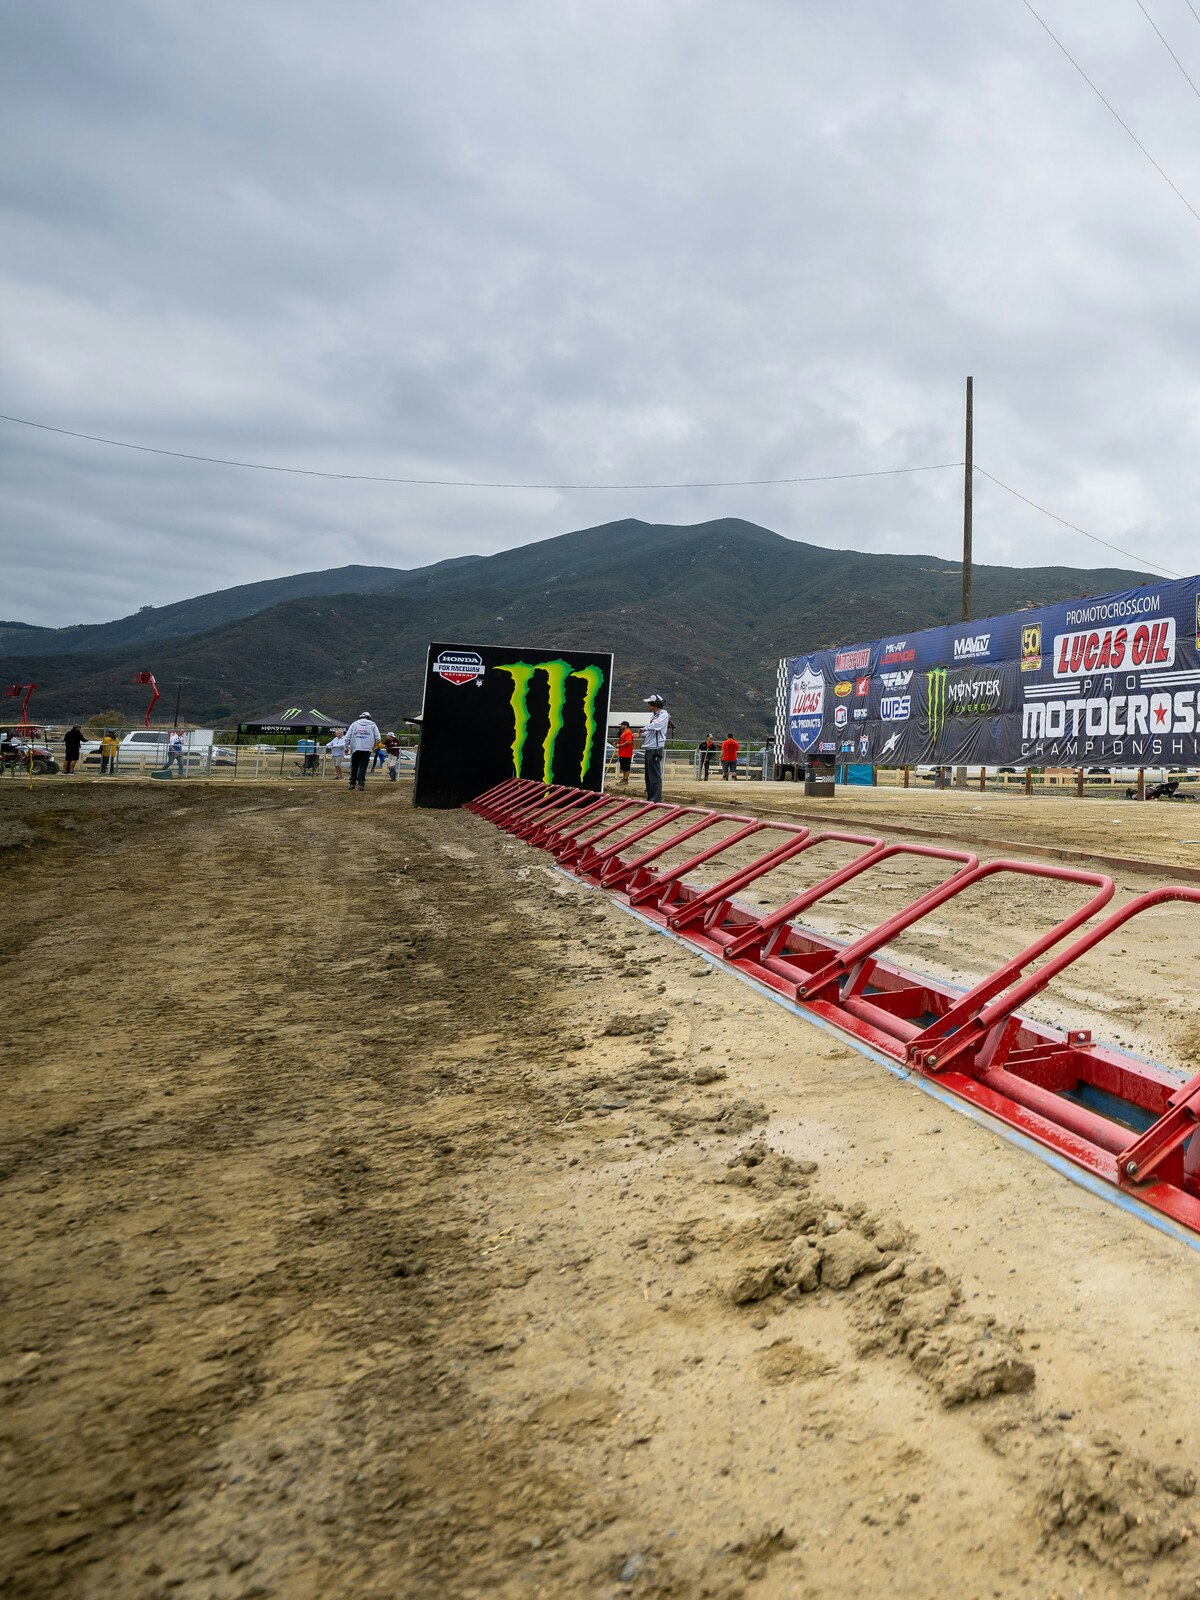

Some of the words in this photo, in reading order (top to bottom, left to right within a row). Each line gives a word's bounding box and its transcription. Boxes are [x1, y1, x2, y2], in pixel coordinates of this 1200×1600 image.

[1066, 595, 1160, 626] PROMOTOCROSS.COM
[1025, 629, 1039, 653] 50
[1057, 627, 1128, 675] LUCAS
[1131, 622, 1171, 666] OIL
[948, 679, 1000, 701] MONSTER
[1083, 676, 1136, 693] PRO
[793, 692, 821, 714] LUCAS
[954, 703, 991, 712] ENERGY
[798, 719, 820, 728] PRODUCTS
